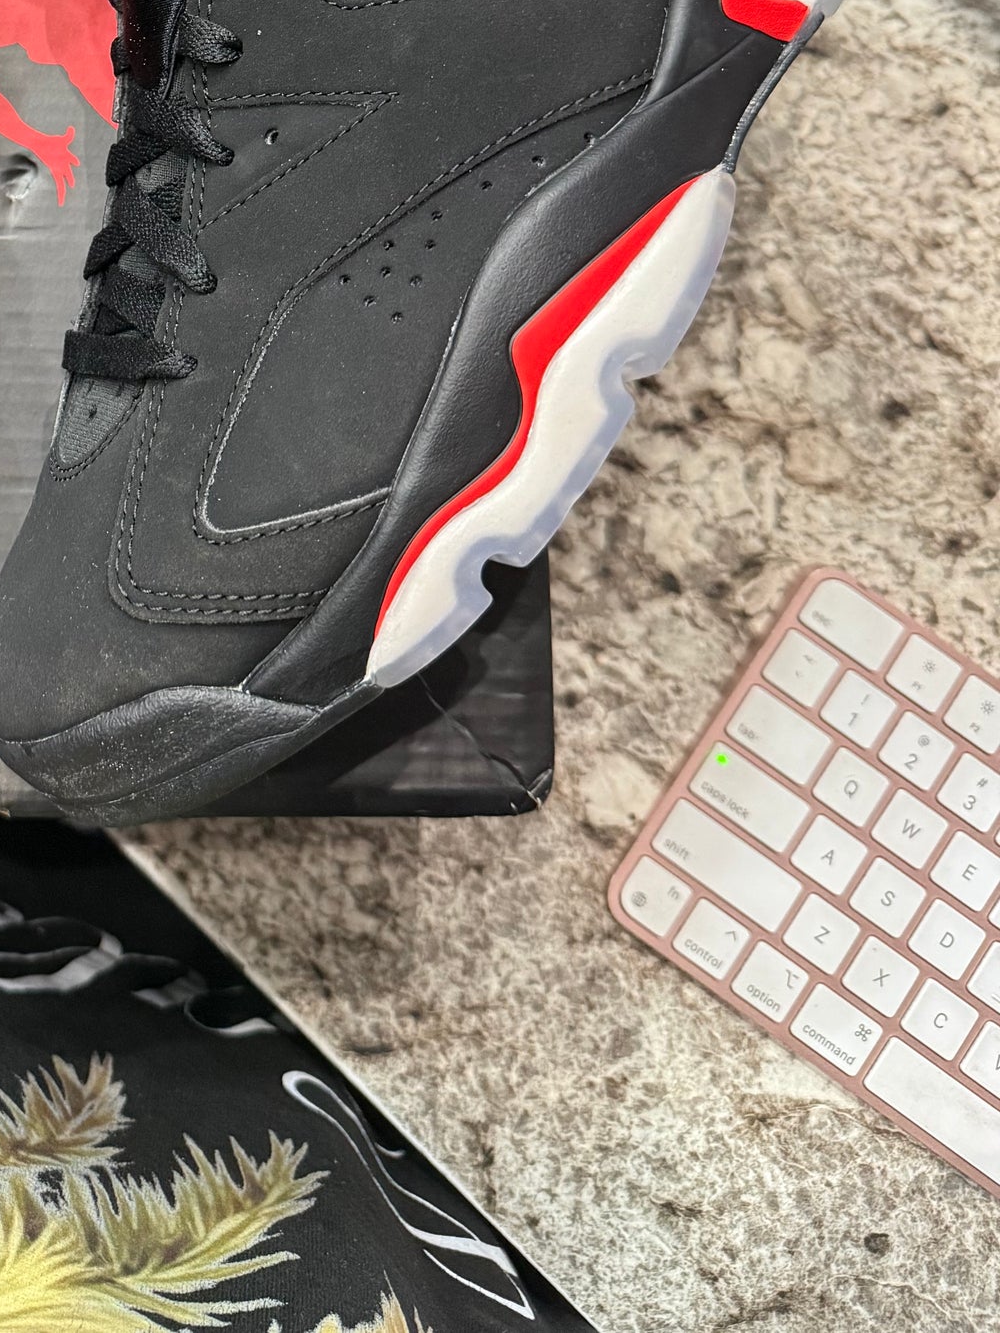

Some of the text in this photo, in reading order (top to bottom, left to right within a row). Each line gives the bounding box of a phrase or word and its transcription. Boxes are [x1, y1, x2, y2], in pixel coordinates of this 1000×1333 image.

[846, 711, 859, 728] 1
[903, 752, 919, 771] 2
[843, 779, 859, 799] Q
[700, 781, 750, 820] caps lock
[962, 794, 977, 811] 3
[901, 818, 922, 840] W
[663, 838, 690, 861] shift
[820, 849, 836, 867] A
[961, 863, 979, 882] E
[880, 890, 896, 907] S
[813, 925, 832, 945] Z
[939, 931, 955, 949] D
[684, 937, 724, 971] control
[872, 968, 891, 988] X
[746, 983, 781, 1013] option
[933, 1012, 949, 1029] C
[802, 1023, 857, 1066] command
